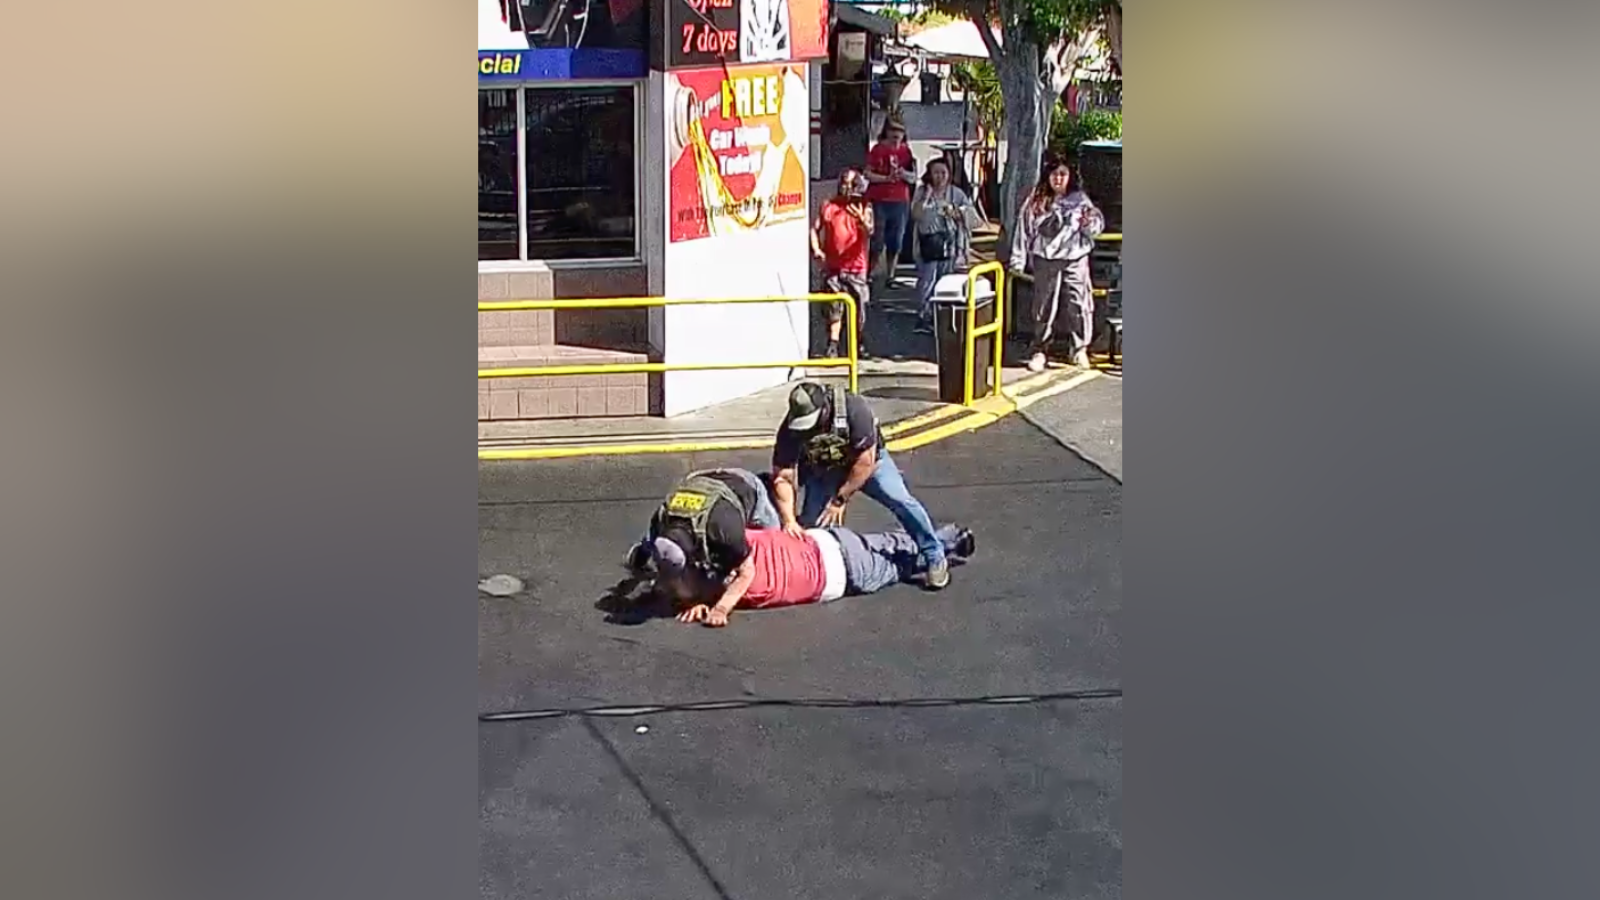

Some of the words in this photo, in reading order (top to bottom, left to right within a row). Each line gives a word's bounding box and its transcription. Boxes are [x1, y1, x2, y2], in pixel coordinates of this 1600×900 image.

[682, 23, 695, 53] 7
[697, 24, 737, 54] days
[478, 52, 522, 74] cial
[722, 77, 778, 119] FREE
[709, 128, 733, 151] Car
